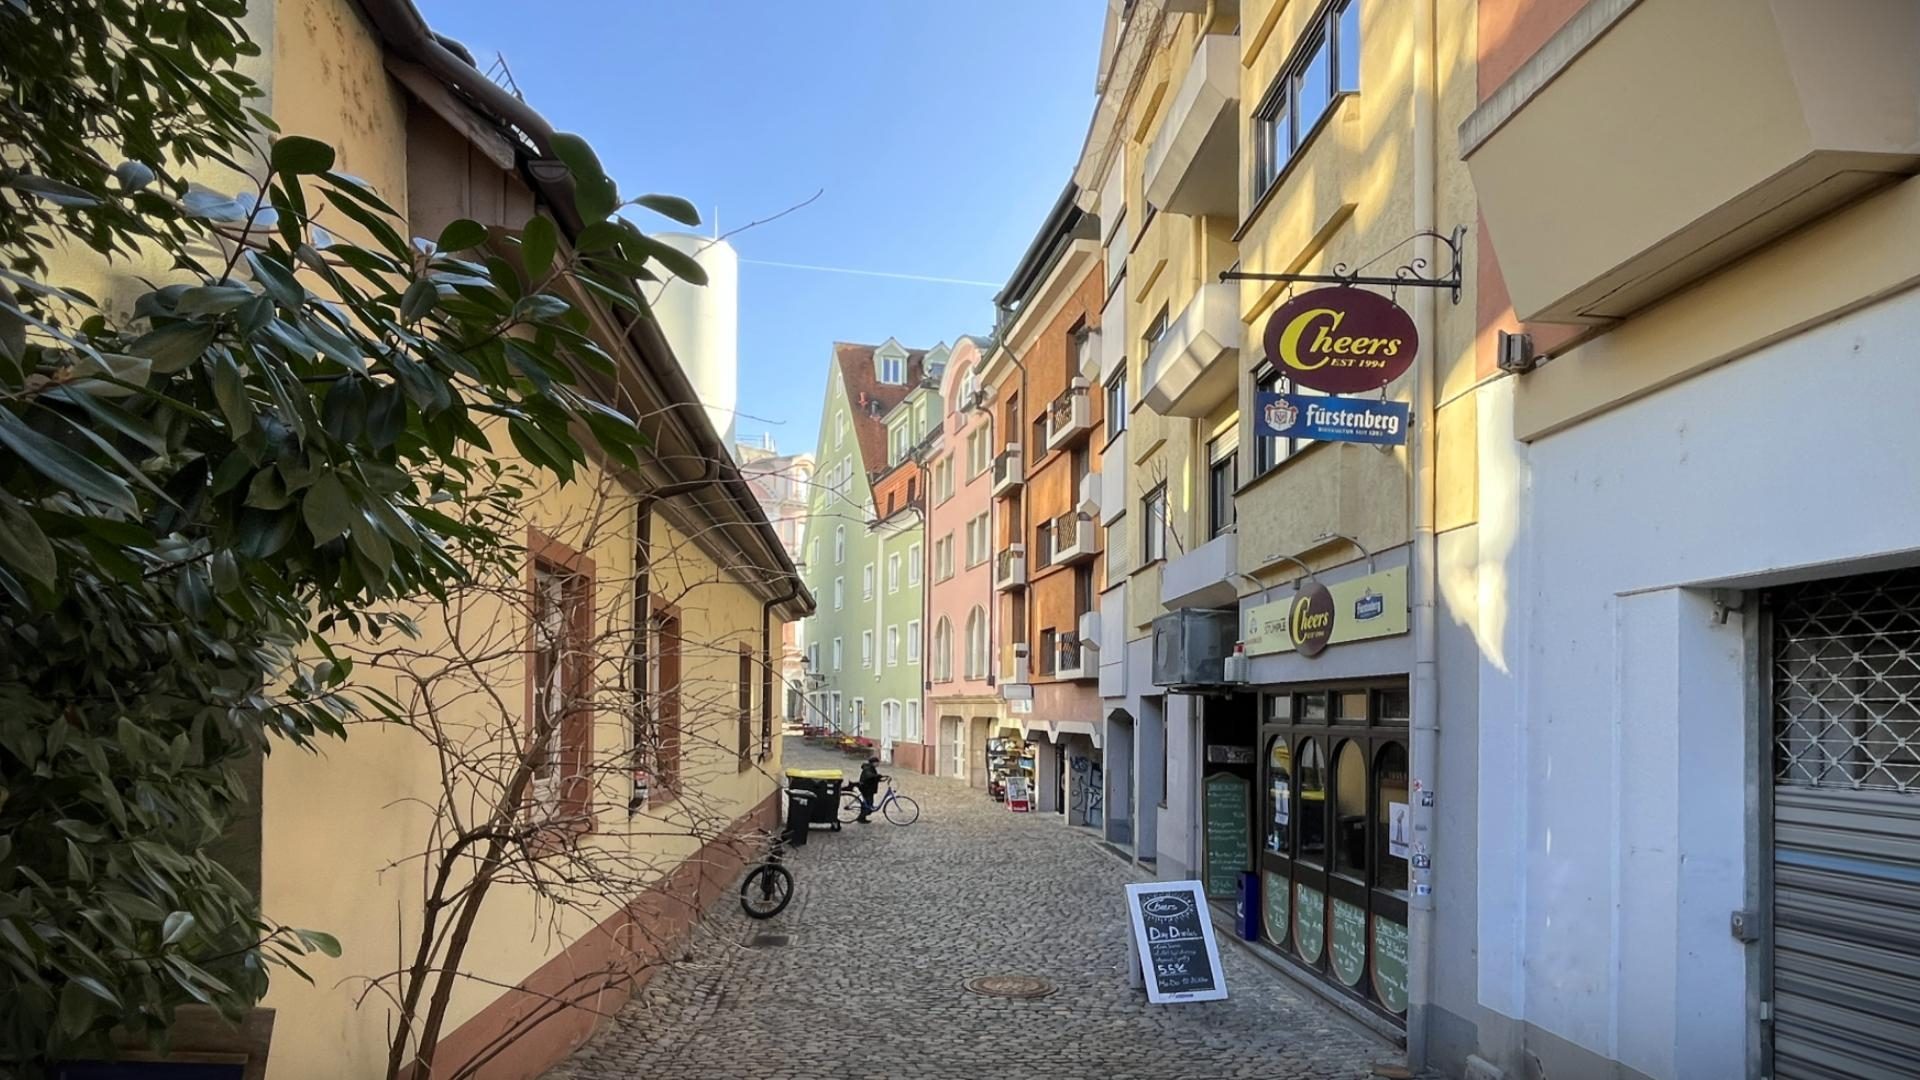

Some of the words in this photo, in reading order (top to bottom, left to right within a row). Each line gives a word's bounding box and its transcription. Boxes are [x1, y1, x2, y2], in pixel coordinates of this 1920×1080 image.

[1279, 308, 1402, 371] Cheers
[1330, 358, 1356, 367] EST
[1358, 359, 1386, 369] 1994
[1306, 403, 1399, 435] Fürstenberg
[1293, 596, 1329, 645] Cheers
